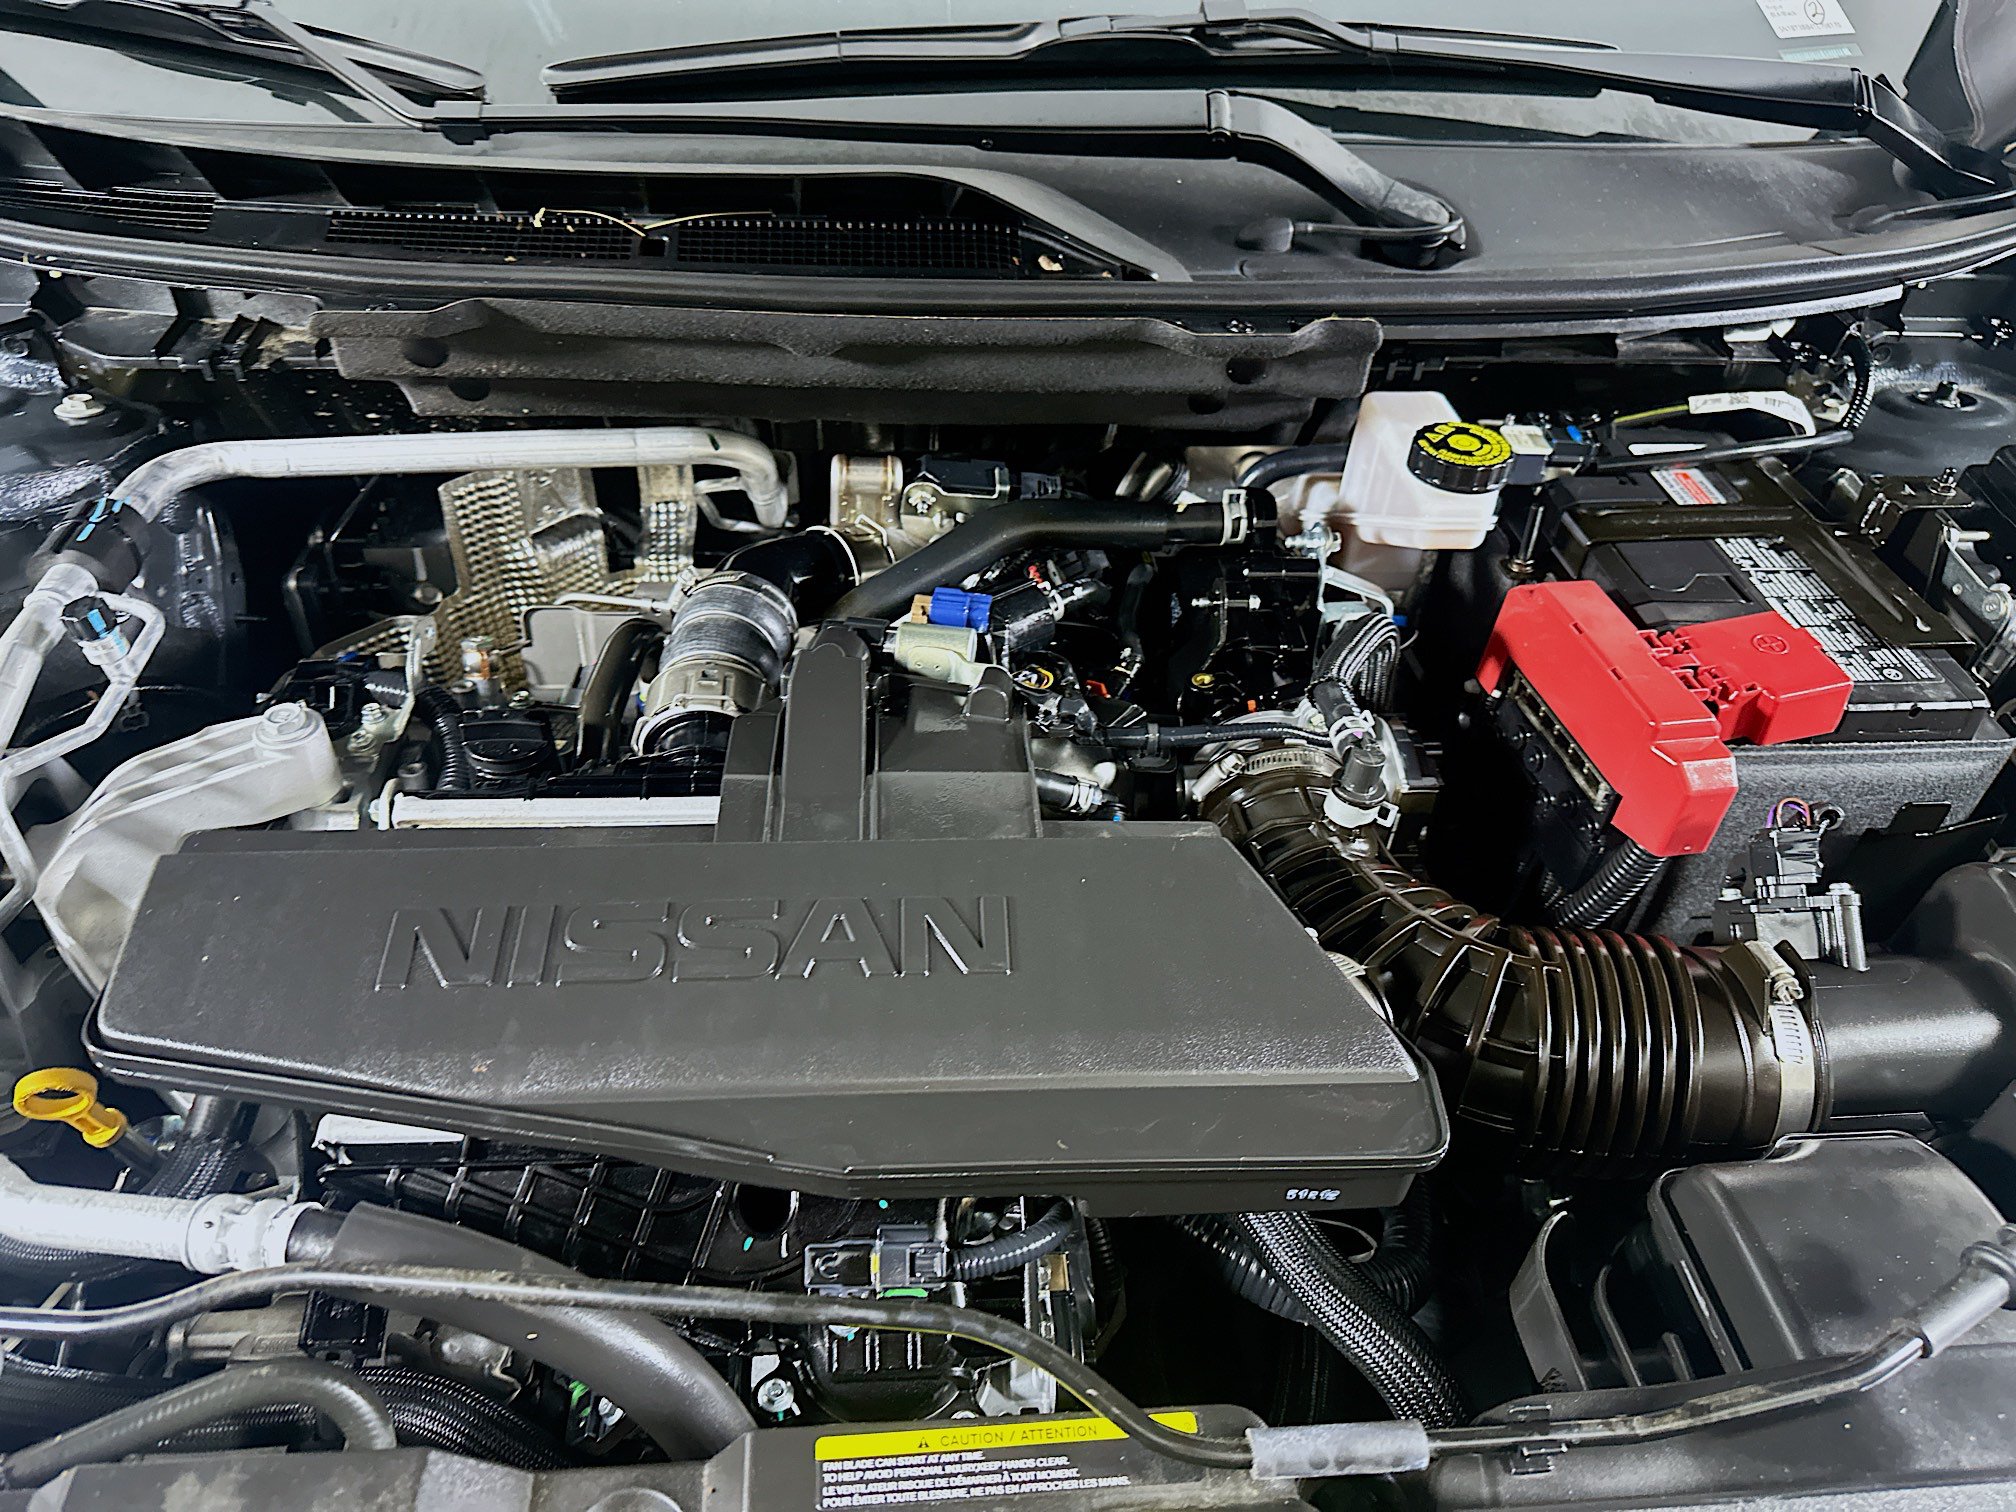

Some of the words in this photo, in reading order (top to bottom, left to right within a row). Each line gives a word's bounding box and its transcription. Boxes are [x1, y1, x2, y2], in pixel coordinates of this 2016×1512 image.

[374, 896, 1013, 992] NISSAN
[940, 1431, 1004, 1447] CAUTION
[1020, 1425, 1098, 1442] ATTENTION
[822, 1461, 843, 1472] FAN
[843, 1458, 875, 1470] BLADE
[875, 1456, 896, 1468] CAN
[896, 1454, 926, 1467] START
[927, 1454, 940, 1463] AT
[940, 1452, 961, 1463] ANY
[822, 1473, 837, 1483] TO
[838, 1470, 863, 1482] HELP
[863, 1468, 893, 1480] AVOID
[894, 1464, 943, 1477] PERSONAL
[1001, 1457, 1036, 1470] HANDS
[822, 1486, 836, 1496] LE
[835, 1481, 897, 1496] VENTILATEUR
[898, 1478, 935, 1490] RISQUE
[935, 1477, 950, 1487] DE
[1010, 1471, 1036, 1482] TOUT
[822, 1497, 852, 1508] POUR
[886, 1491, 917, 1503] TOUTE
[986, 1484, 1005, 1496] PAS
[1005, 1483, 1019, 1495] EN
[1019, 1480, 1080, 1493] APPROCHER
[1079, 1477, 1098, 1489] LES
